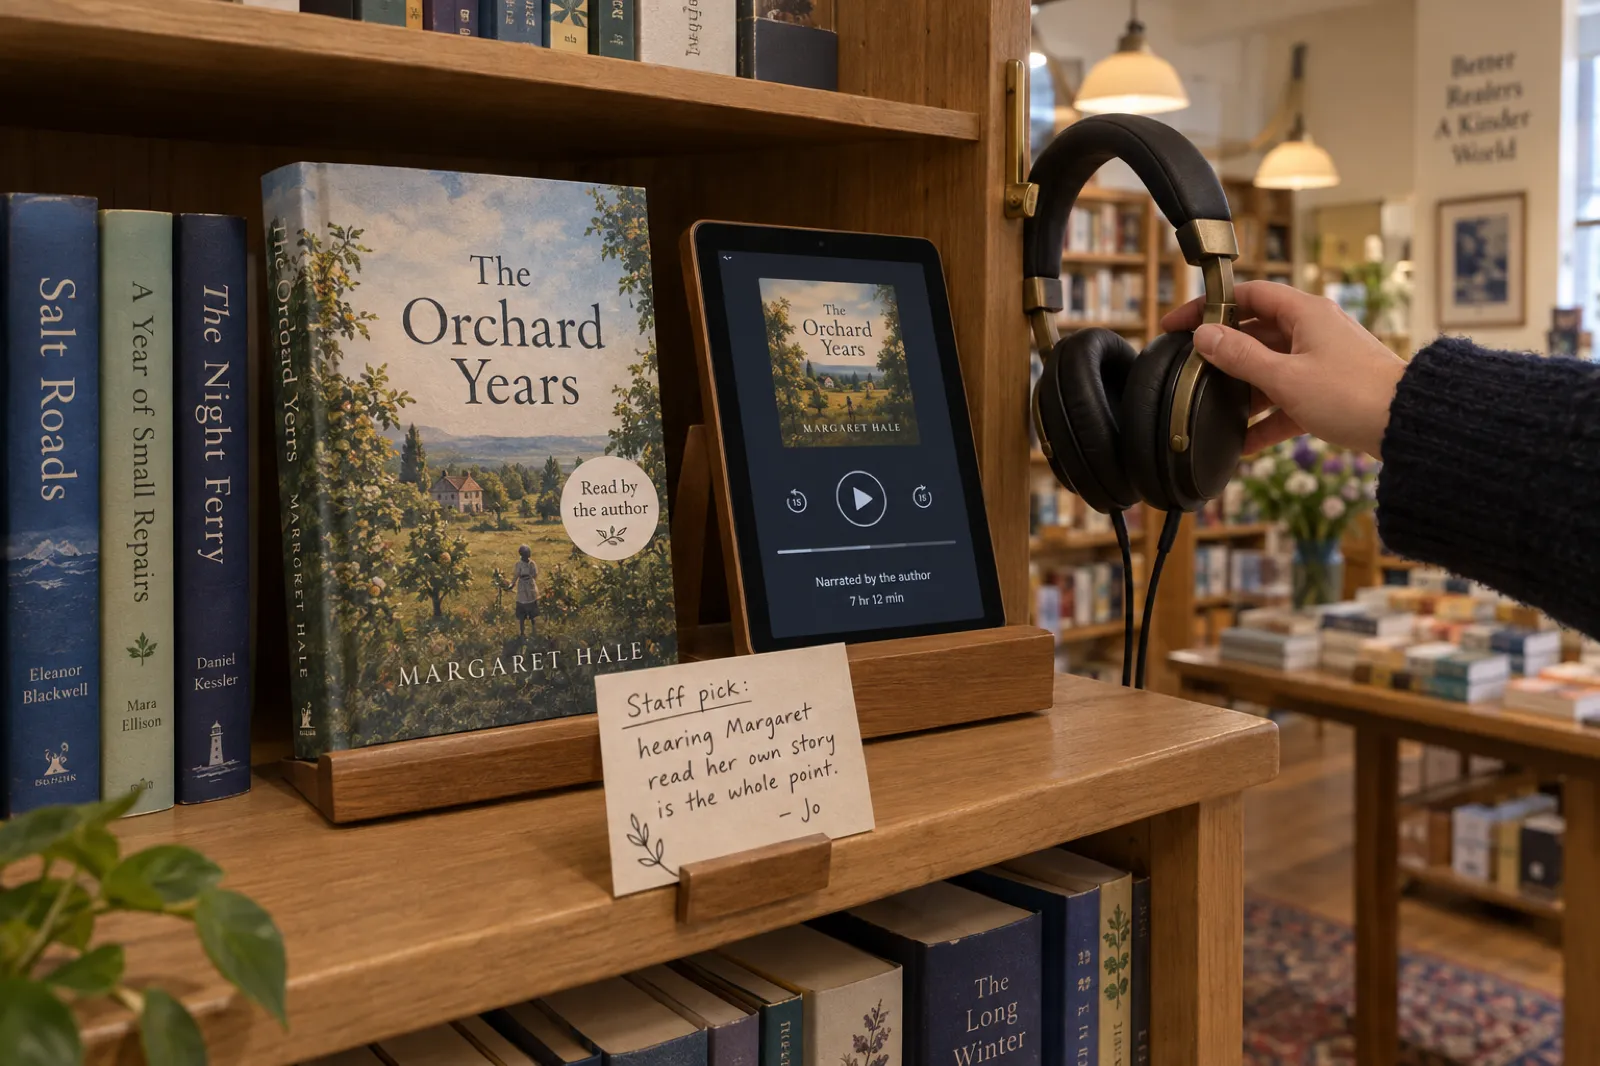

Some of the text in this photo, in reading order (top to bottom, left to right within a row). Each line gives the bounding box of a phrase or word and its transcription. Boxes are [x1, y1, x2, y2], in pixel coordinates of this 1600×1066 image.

[1434, 117, 1451, 140] A
[272, 218, 289, 270] The
[470, 255, 531, 286] The
[823, 304, 846, 316] The
[402, 297, 605, 349] Orchard
[803, 319, 872, 337] Orchard
[821, 339, 865, 357] Years
[40, 277, 78, 500] Salt Roads
[451, 358, 579, 405] Years
[195, 284, 232, 564] The Night Ferry
[803, 423, 901, 433] MARGARET HALE
[126, 281, 156, 602] A Year of Small Repairs
[581, 479, 638, 498] Read by
[573, 501, 648, 517] the author
[815, 570, 931, 588] Narrated by the author
[850, 593, 904, 606] 7 hr 12 min
[197, 653, 235, 670] Daniel
[297, 624, 308, 678] HALE
[29, 666, 82, 683] Eleanor
[398, 642, 644, 687] MARGARET HALE
[23, 683, 88, 704] Blackwell
[194, 674, 238, 691] Kessler
[127, 699, 157, 713] Mara
[627, 679, 749, 718] Staff pick:
[122, 716, 161, 732] Ellison
[637, 702, 812, 759] hearing Margaret
[648, 733, 835, 790] read her own story
[657, 759, 838, 819] is the whole point.
[801, 798, 821, 823] Jo
[975, 975, 1009, 999] The
[966, 1001, 1018, 1033] Long
[953, 1030, 1026, 1066] Winter
